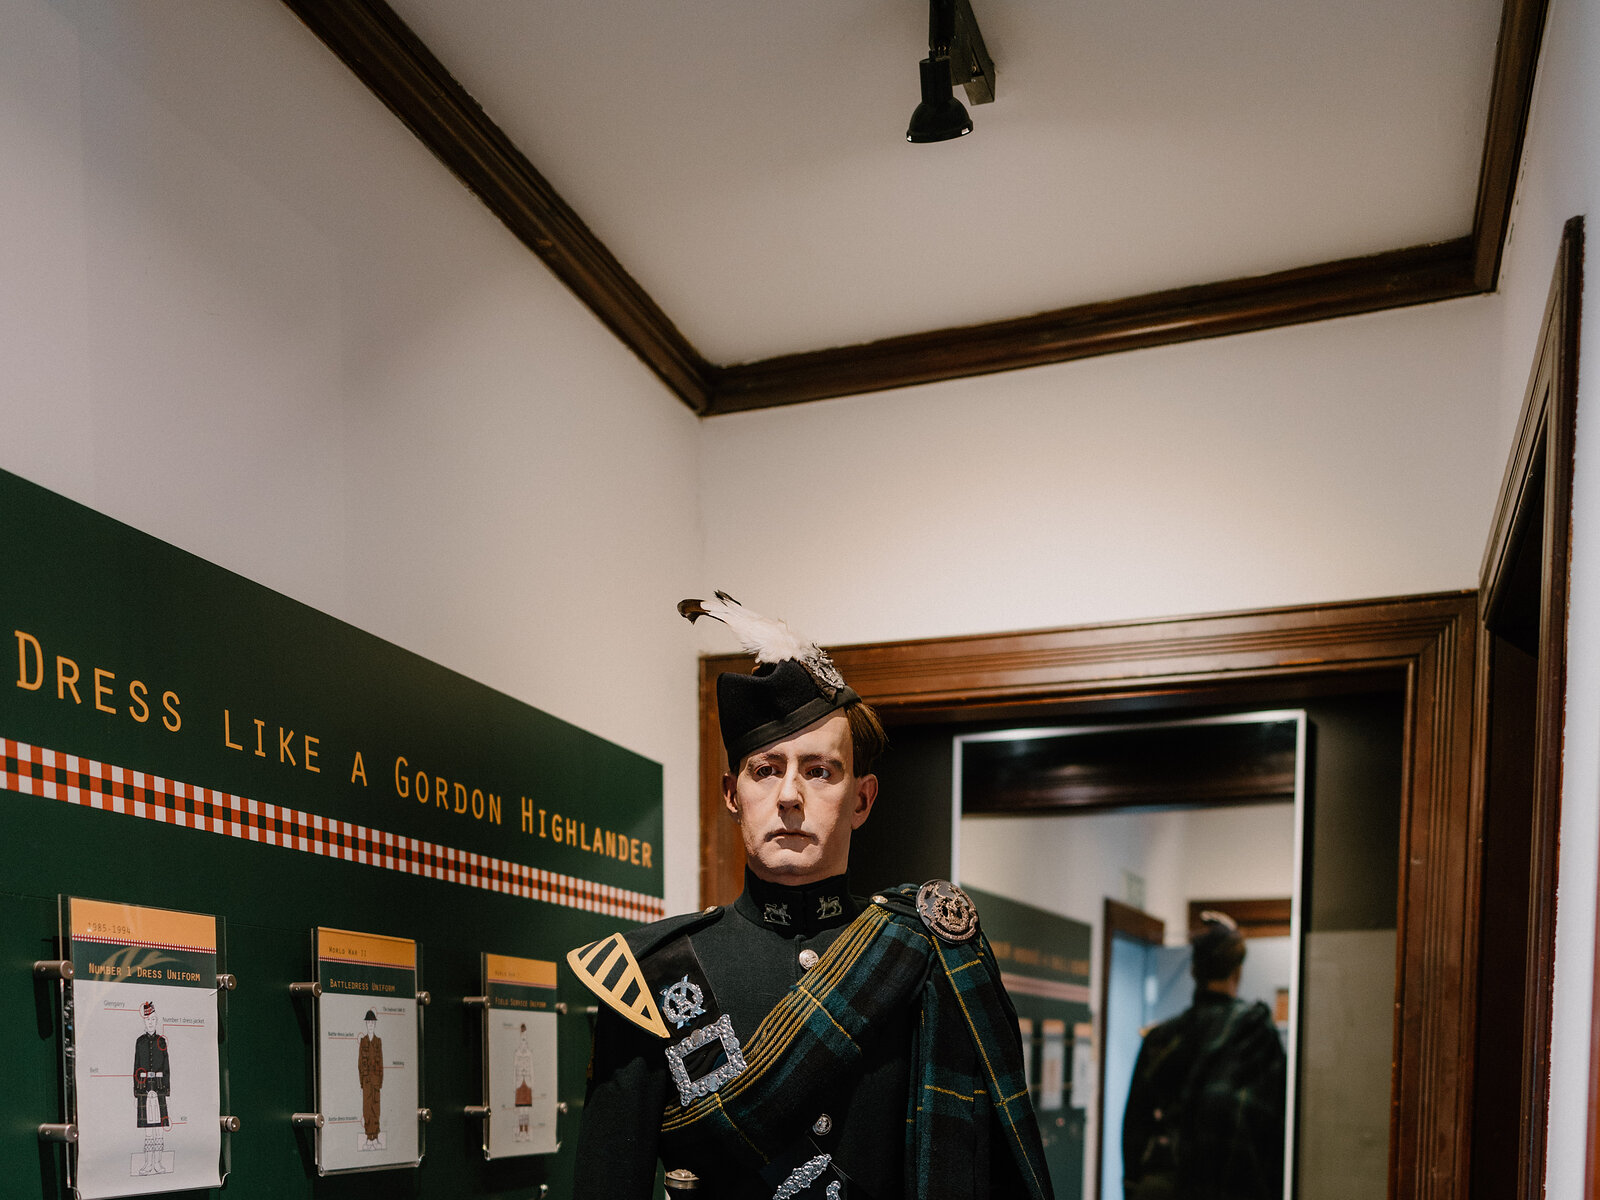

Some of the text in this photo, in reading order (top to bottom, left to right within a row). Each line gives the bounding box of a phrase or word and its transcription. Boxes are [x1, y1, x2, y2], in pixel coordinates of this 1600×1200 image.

[13, 630, 653, 869] DRESS LIKE A GORDON HIGHLANDER
[88, 963, 201, 982] NUMBER 1 DRESS UNIFORM
[329, 978, 396, 992] BATTLEDRESS UNIFORM
